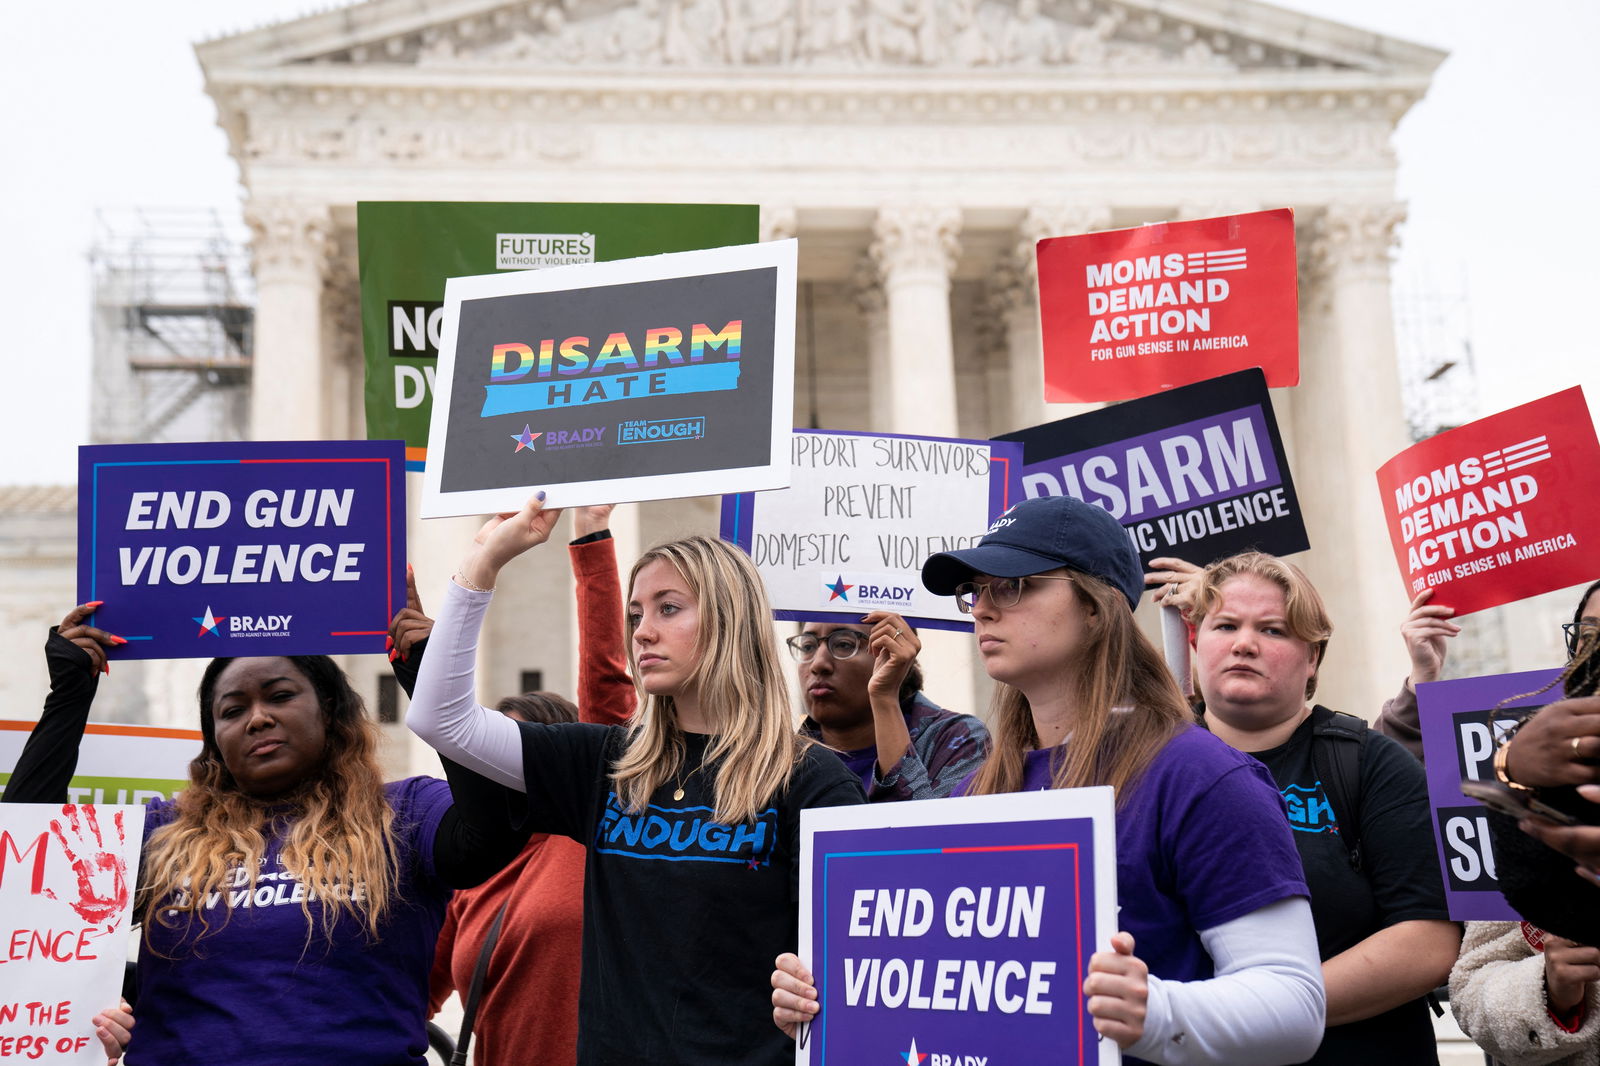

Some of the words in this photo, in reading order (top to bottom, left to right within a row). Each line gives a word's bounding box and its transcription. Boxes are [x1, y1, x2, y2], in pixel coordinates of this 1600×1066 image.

[501, 238, 591, 255] FUTURES
[501, 257, 541, 265] WITHOUT
[1086, 253, 1185, 288] MOMS
[1088, 278, 1230, 316] DEMAND
[1089, 308, 1210, 344] ACTION
[490, 320, 743, 383] DISARM
[1091, 348, 1113, 361] FOR
[1116, 345, 1135, 359] GUN
[1138, 340, 1174, 356] SENSE
[1176, 339, 1189, 351] IN
[1193, 335, 1249, 351] AMERICA
[547, 372, 668, 406] HATE
[545, 426, 606, 446] BRADY
[623, 422, 701, 441] ENOUGH
[624, 420, 647, 428] TEAM
[791, 436, 859, 468] PPORT
[873, 438, 990, 478] SURVIVORS
[824, 484, 917, 519] PREVENT
[1395, 457, 1484, 514] MOMS
[124, 491, 231, 530] END
[244, 488, 354, 528] GUN
[1158, 488, 1290, 547] VIOLENCE
[1400, 474, 1539, 544] DEMAND
[755, 533, 850, 570] DOMESTIC
[1408, 510, 1528, 575] ACTION
[119, 543, 365, 586] VIOLENCE
[1412, 575, 1426, 594] FOR
[1427, 568, 1453, 587] GUN
[1454, 555, 1497, 579] SENSE
[1496, 551, 1512, 566] IN
[1515, 532, 1577, 562] AMERICA
[858, 585, 914, 600] BRADY
[230, 615, 292, 631] BRADY
[848, 888, 934, 937] END
[945, 885, 1045, 938] GUN
[0, 927, 98, 963] ENCE
[844, 958, 1057, 1015] VIOLENCE
[25, 1000, 71, 1026] THE
[55, 1036, 90, 1053] OF
